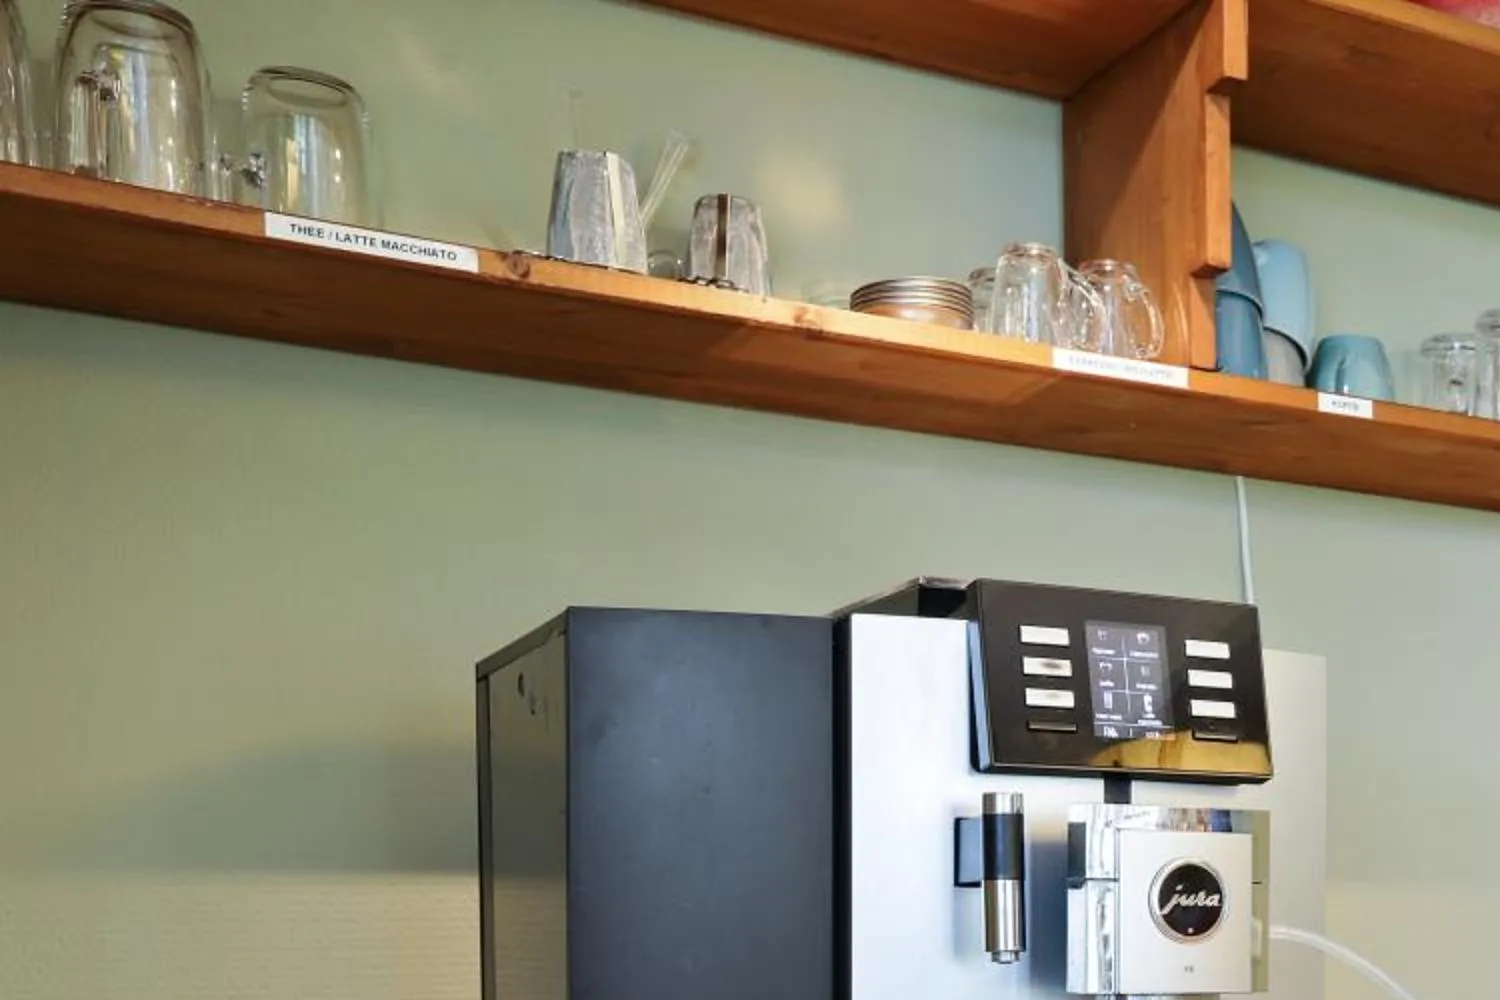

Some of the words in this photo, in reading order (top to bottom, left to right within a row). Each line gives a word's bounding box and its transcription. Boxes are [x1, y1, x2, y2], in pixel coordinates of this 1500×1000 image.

[289, 223, 325, 239] THEE
[335, 232, 377, 248] LATTE
[381, 239, 458, 261] MACCHIATO
[1158, 884, 1222, 916] jura
